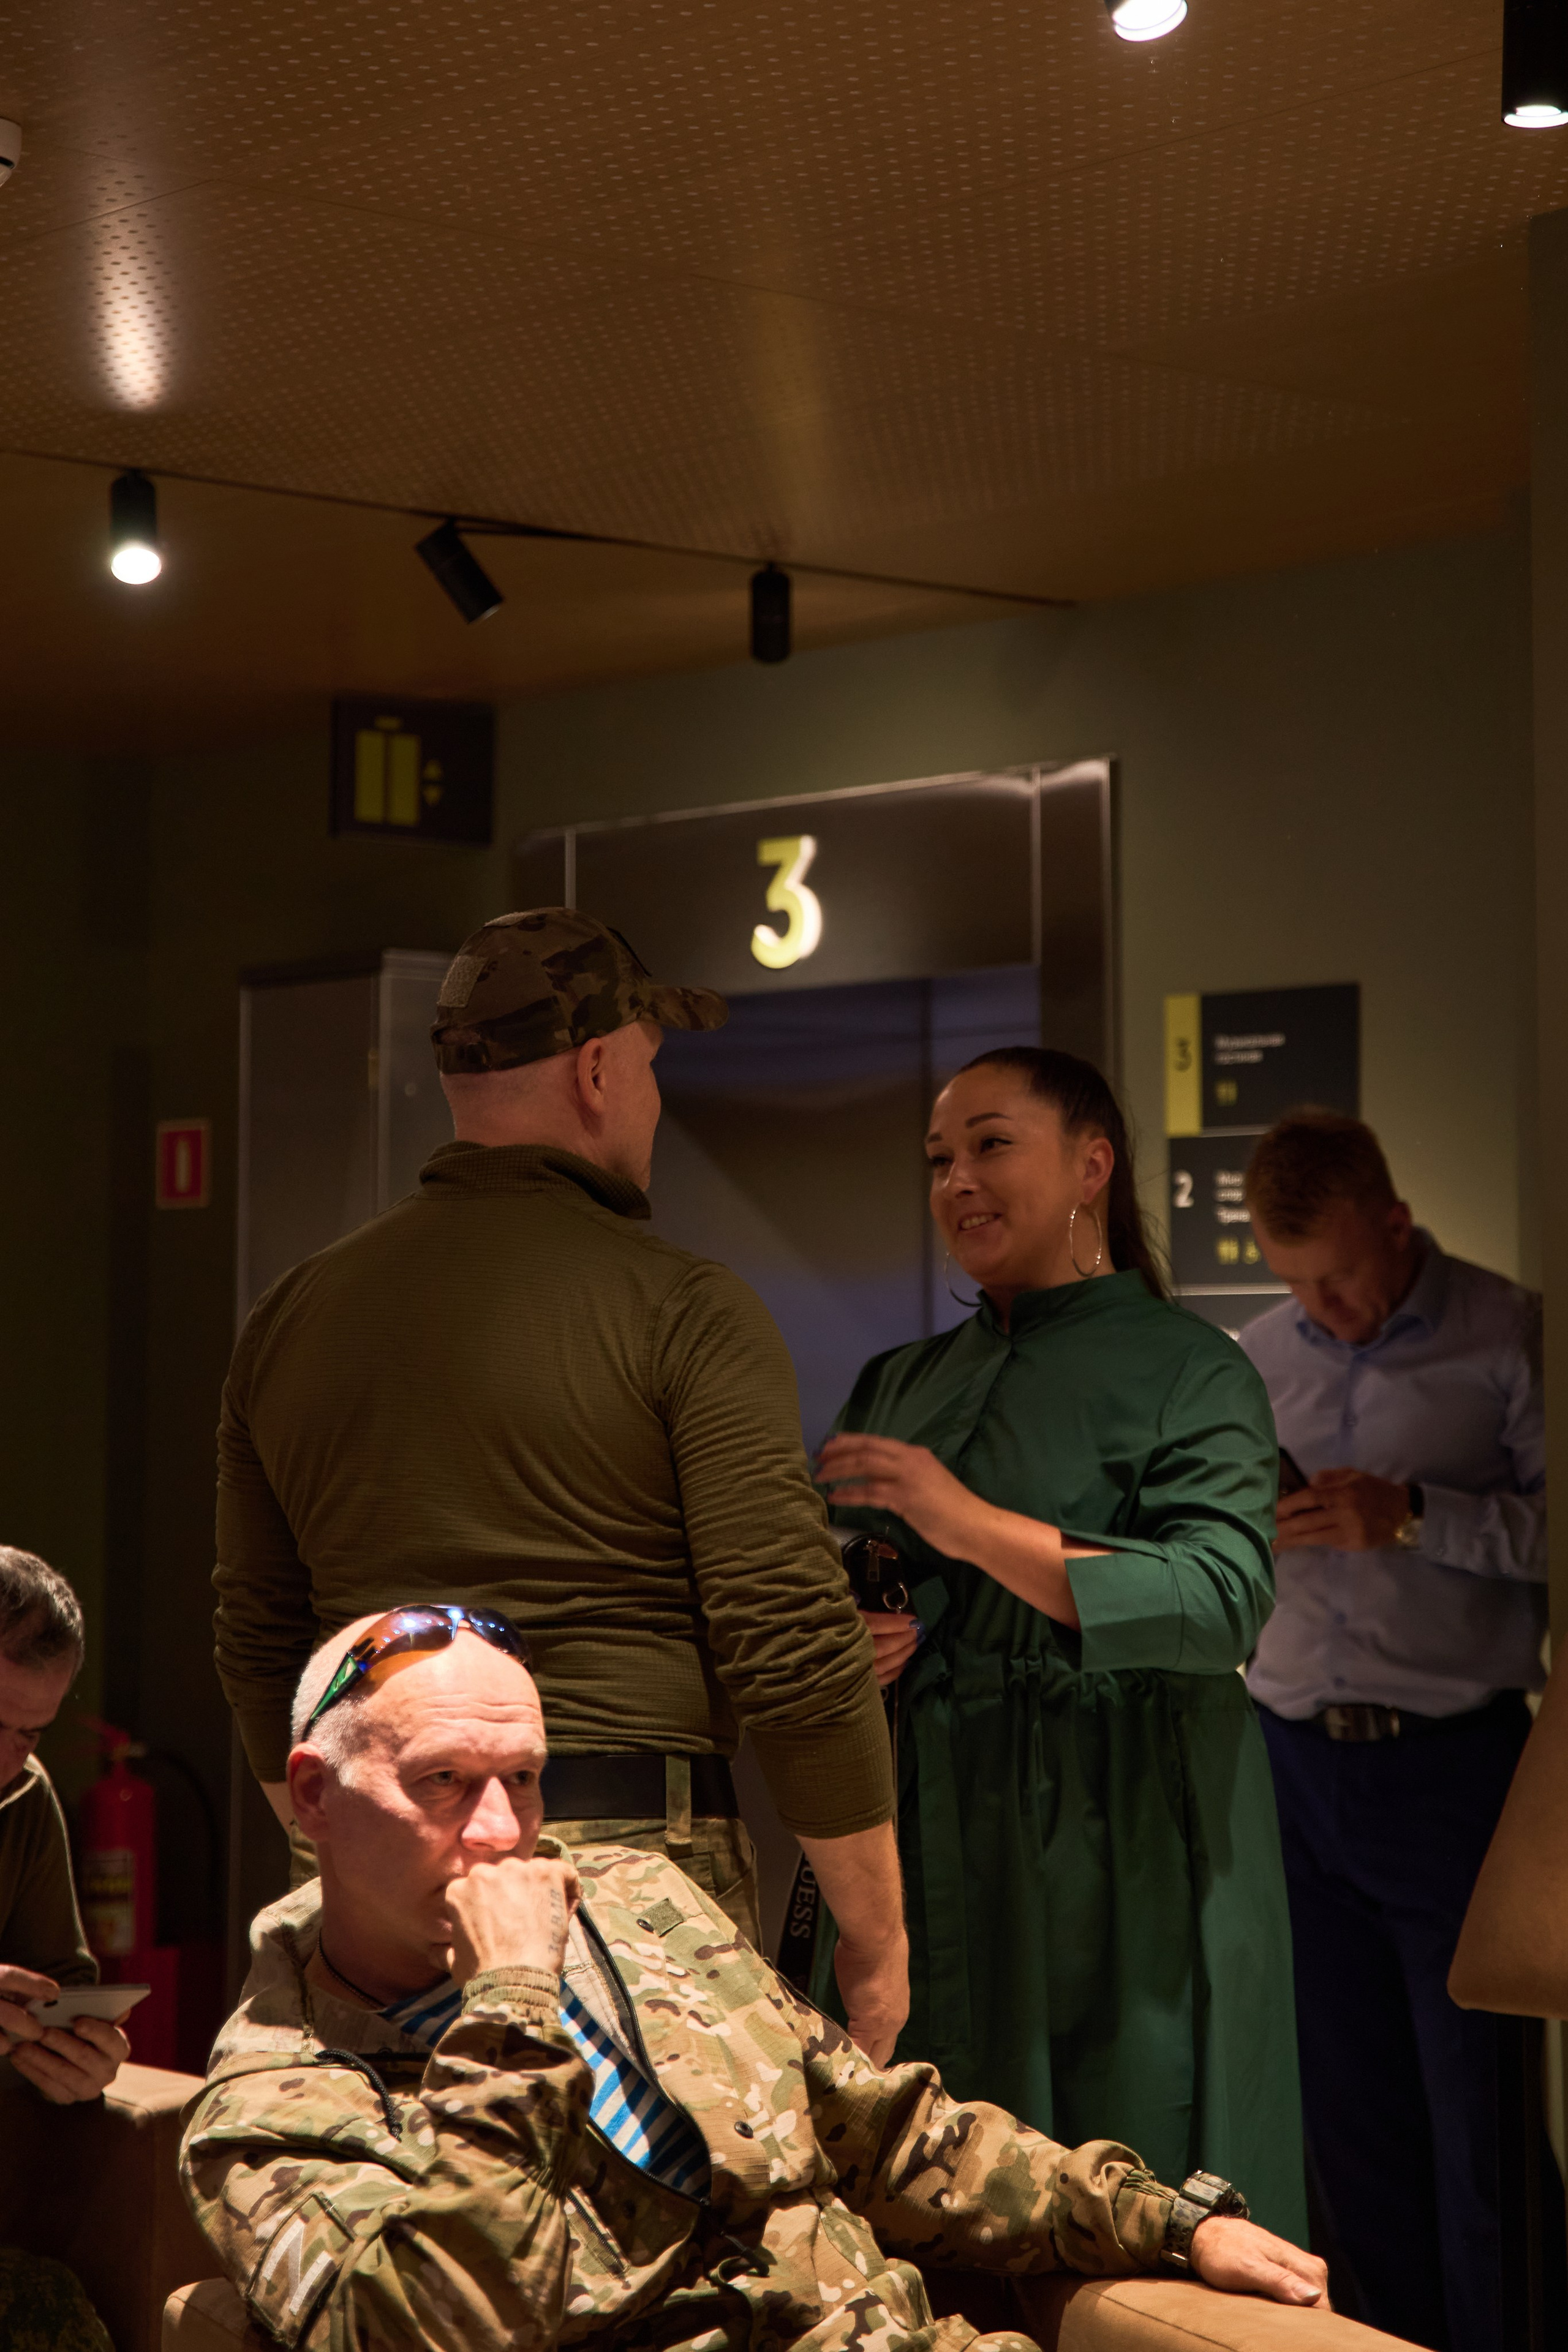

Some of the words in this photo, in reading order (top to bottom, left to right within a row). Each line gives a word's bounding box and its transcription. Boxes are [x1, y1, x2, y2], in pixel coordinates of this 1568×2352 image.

[752, 835, 822, 970] 3
[1176, 1037, 1193, 1072] 3
[1174, 1169, 1194, 1208] 2
[790, 1860, 815, 1938] UESS
